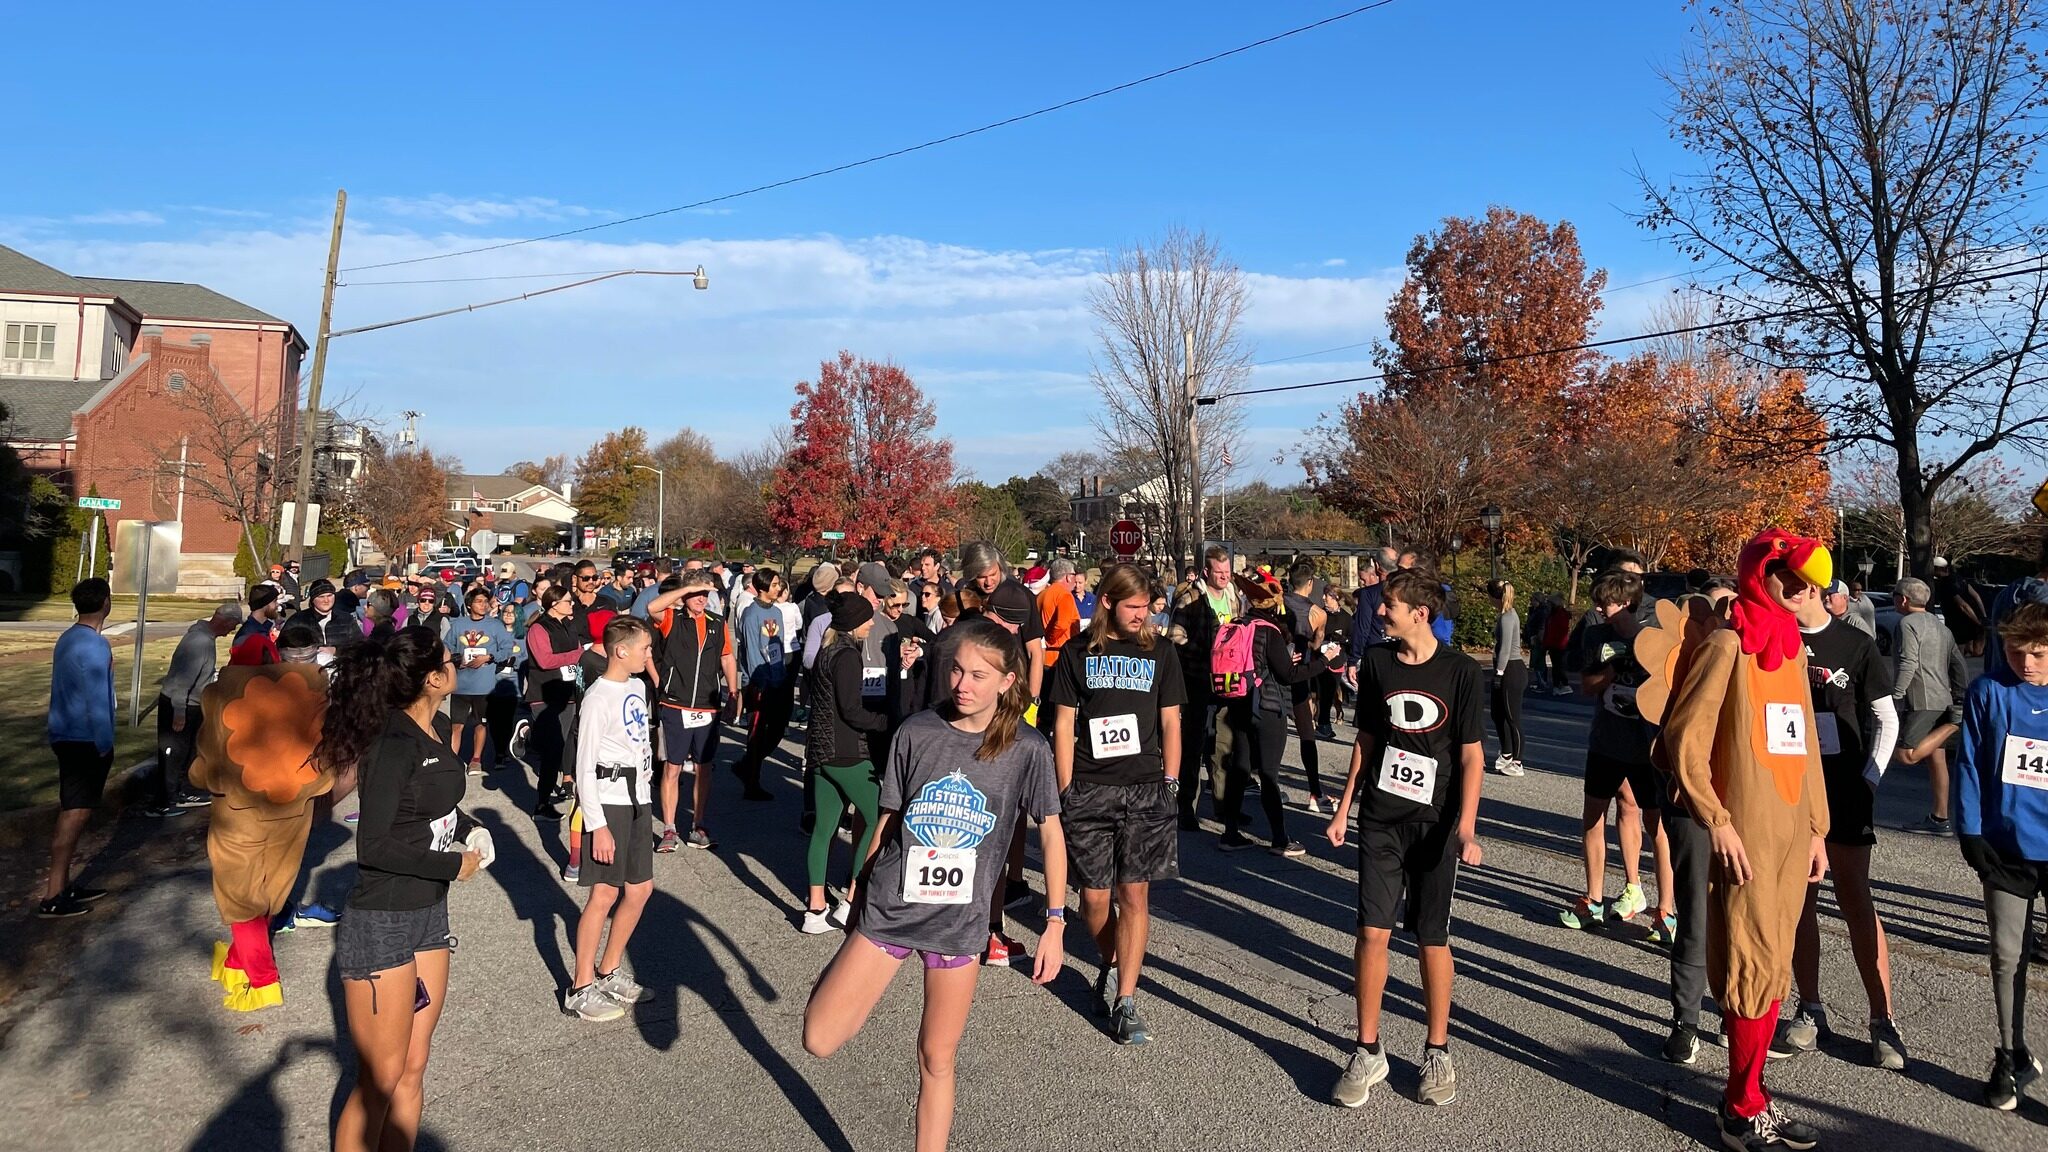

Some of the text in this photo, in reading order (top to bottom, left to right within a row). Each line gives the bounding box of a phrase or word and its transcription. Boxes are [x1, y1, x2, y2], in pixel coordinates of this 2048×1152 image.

[81, 498, 103, 507] CANAL
[1112, 531, 1141, 545] STOP
[1085, 656, 1156, 680] HATTON
[865, 677, 881, 687] 172
[1086, 677, 1154, 692] CROSS COUNTRY
[691, 711, 703, 720] 56
[1099, 728, 1131, 744] 120
[1786, 720, 1796, 738] 4
[2017, 753, 2048, 774] 14
[1390, 763, 1425, 788] 192
[942, 783, 968, 794] AHSAA
[934, 790, 972, 807] STATE
[906, 801, 992, 828] CHAMPIONSHIPS
[919, 866, 964, 887] 190
